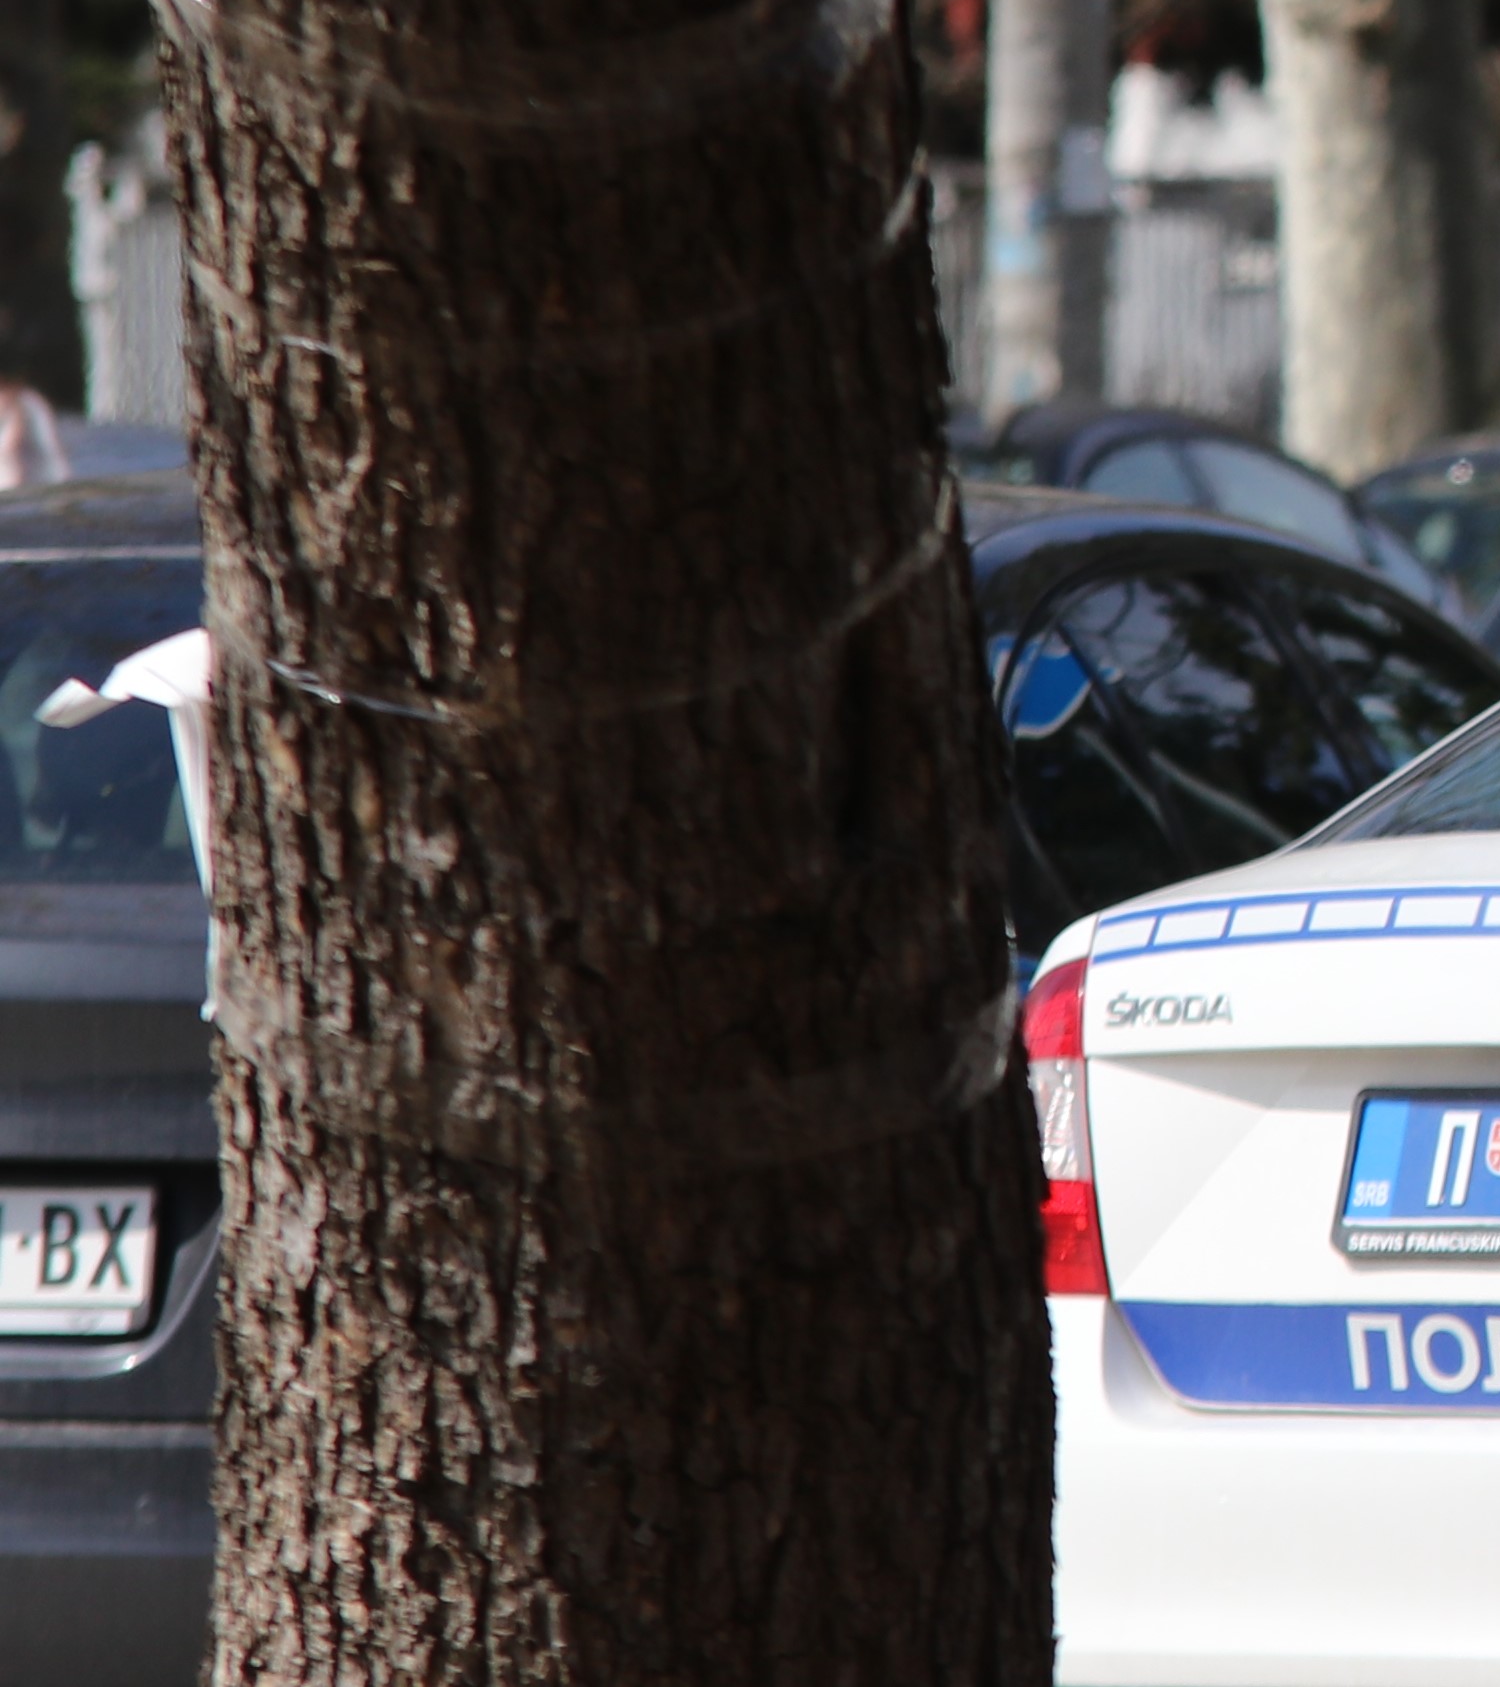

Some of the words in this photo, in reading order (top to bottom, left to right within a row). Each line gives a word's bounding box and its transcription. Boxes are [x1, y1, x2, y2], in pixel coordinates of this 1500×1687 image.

[1105, 991, 1233, 1027] ŠKODA
[1352, 1180, 1390, 1208] SRB
[1347, 1231, 1403, 1253] SERVIS
